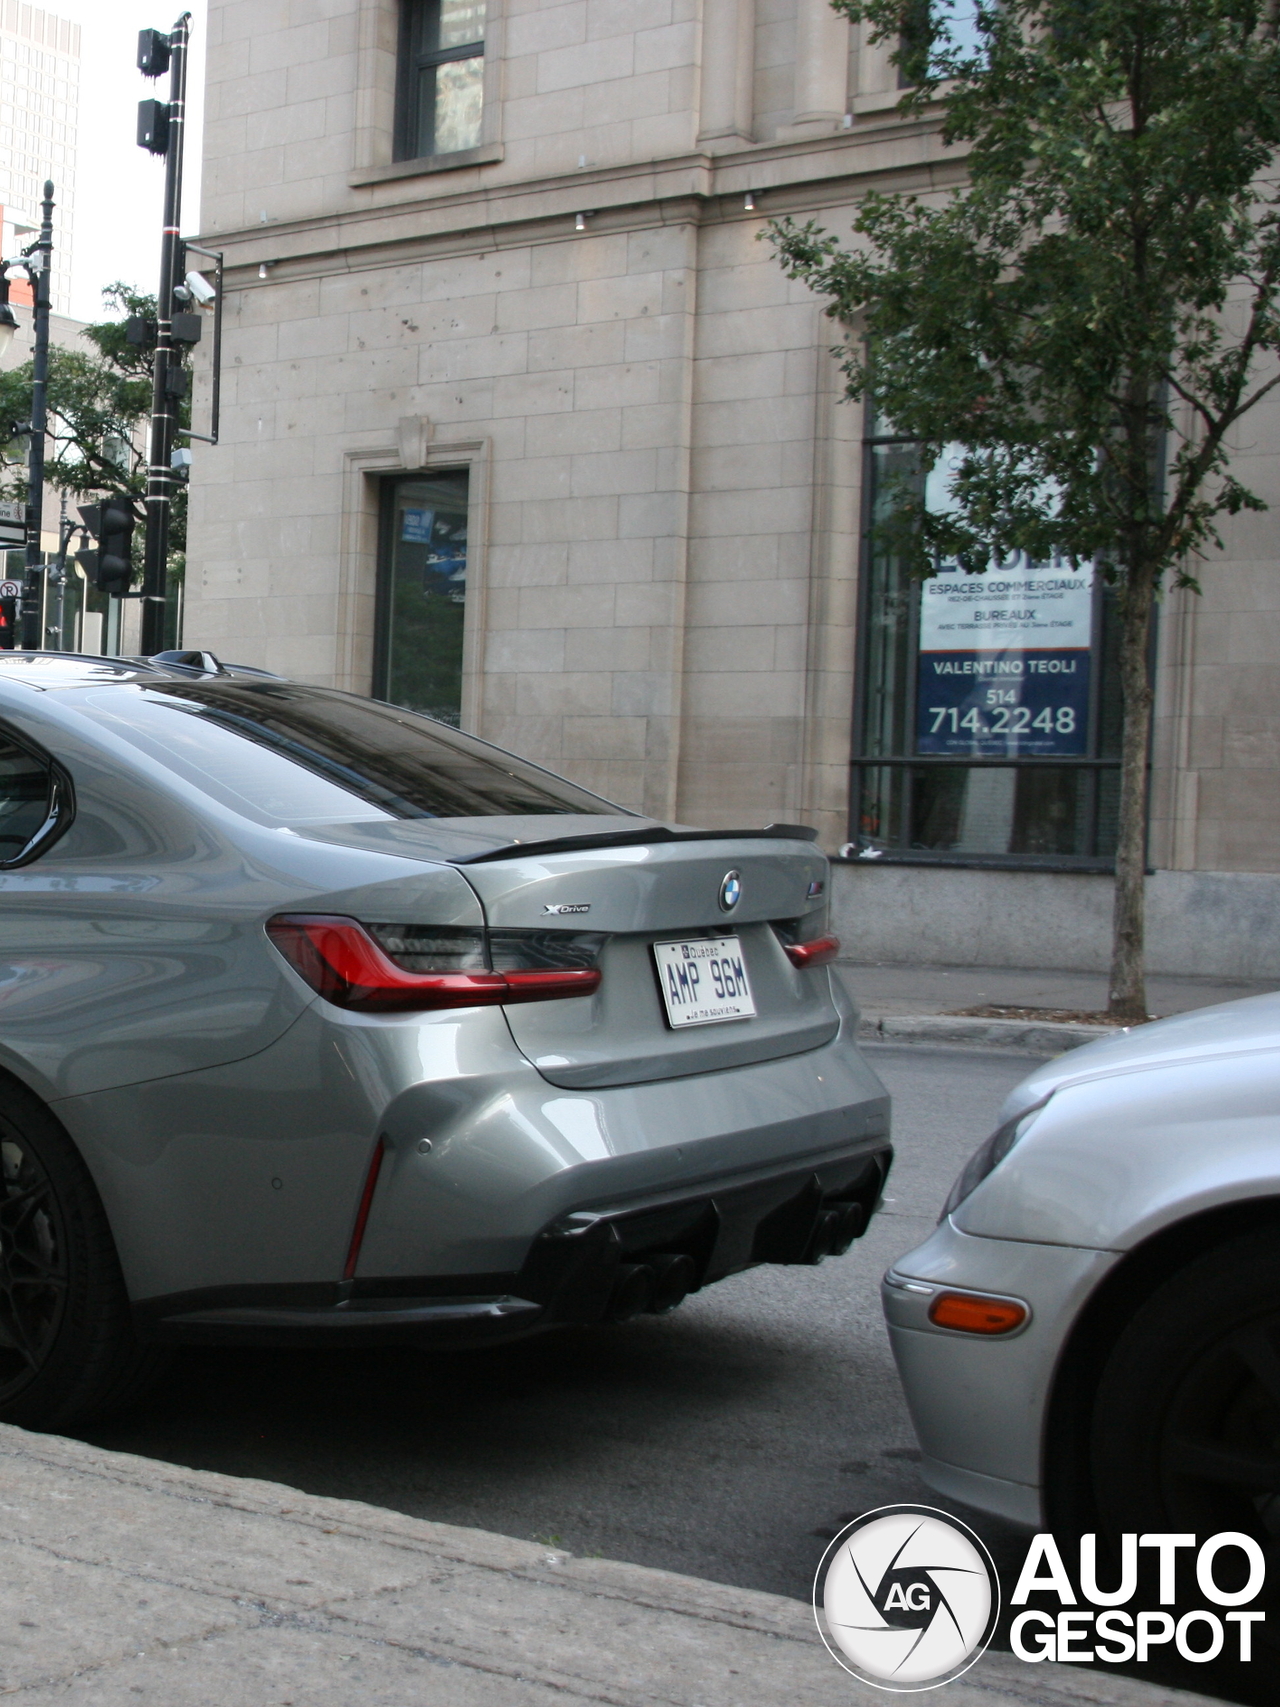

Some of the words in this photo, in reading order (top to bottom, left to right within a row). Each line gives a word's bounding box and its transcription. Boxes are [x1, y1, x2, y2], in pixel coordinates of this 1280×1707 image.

[929, 583, 984, 595] ESPACES
[987, 579, 1085, 593] COMMERCIAUX
[973, 609, 1037, 622] BUREAUX
[933, 661, 1024, 675] VALENTINO
[1027, 660, 1077, 674] TEOLI
[986, 689, 1017, 705] 514
[928, 706, 1076, 734] 714.2248
[689, 945, 719, 959] Québec
[666, 961, 700, 1006] AMP
[710, 957, 748, 999] 96M
